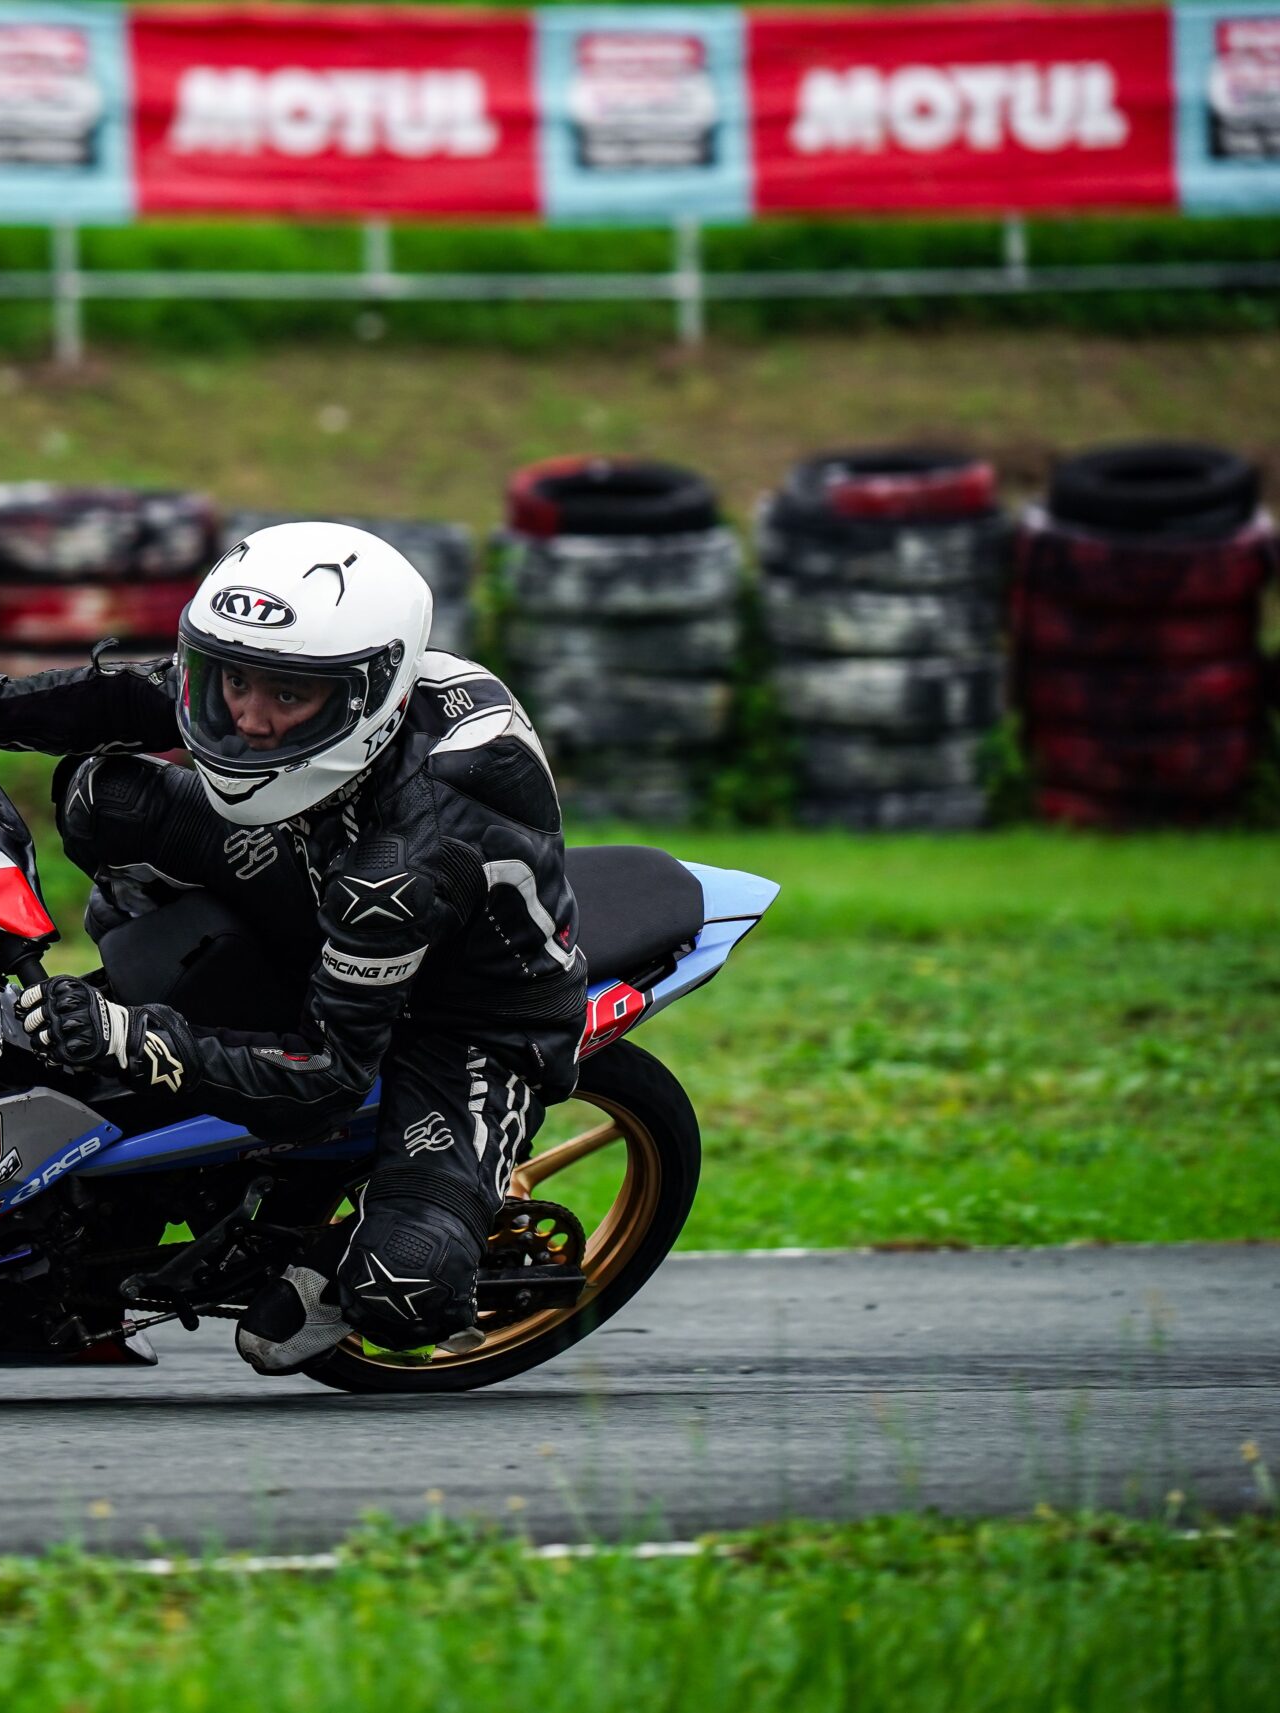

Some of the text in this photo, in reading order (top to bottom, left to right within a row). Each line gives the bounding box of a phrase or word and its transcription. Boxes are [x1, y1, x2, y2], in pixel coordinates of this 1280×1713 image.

[167, 67, 499, 157] MOTUL
[790, 60, 1130, 152] MOTUL
[217, 591, 288, 622] KYT
[322, 951, 413, 979] RACING FIT
[42, 1136, 102, 1185] RCB
